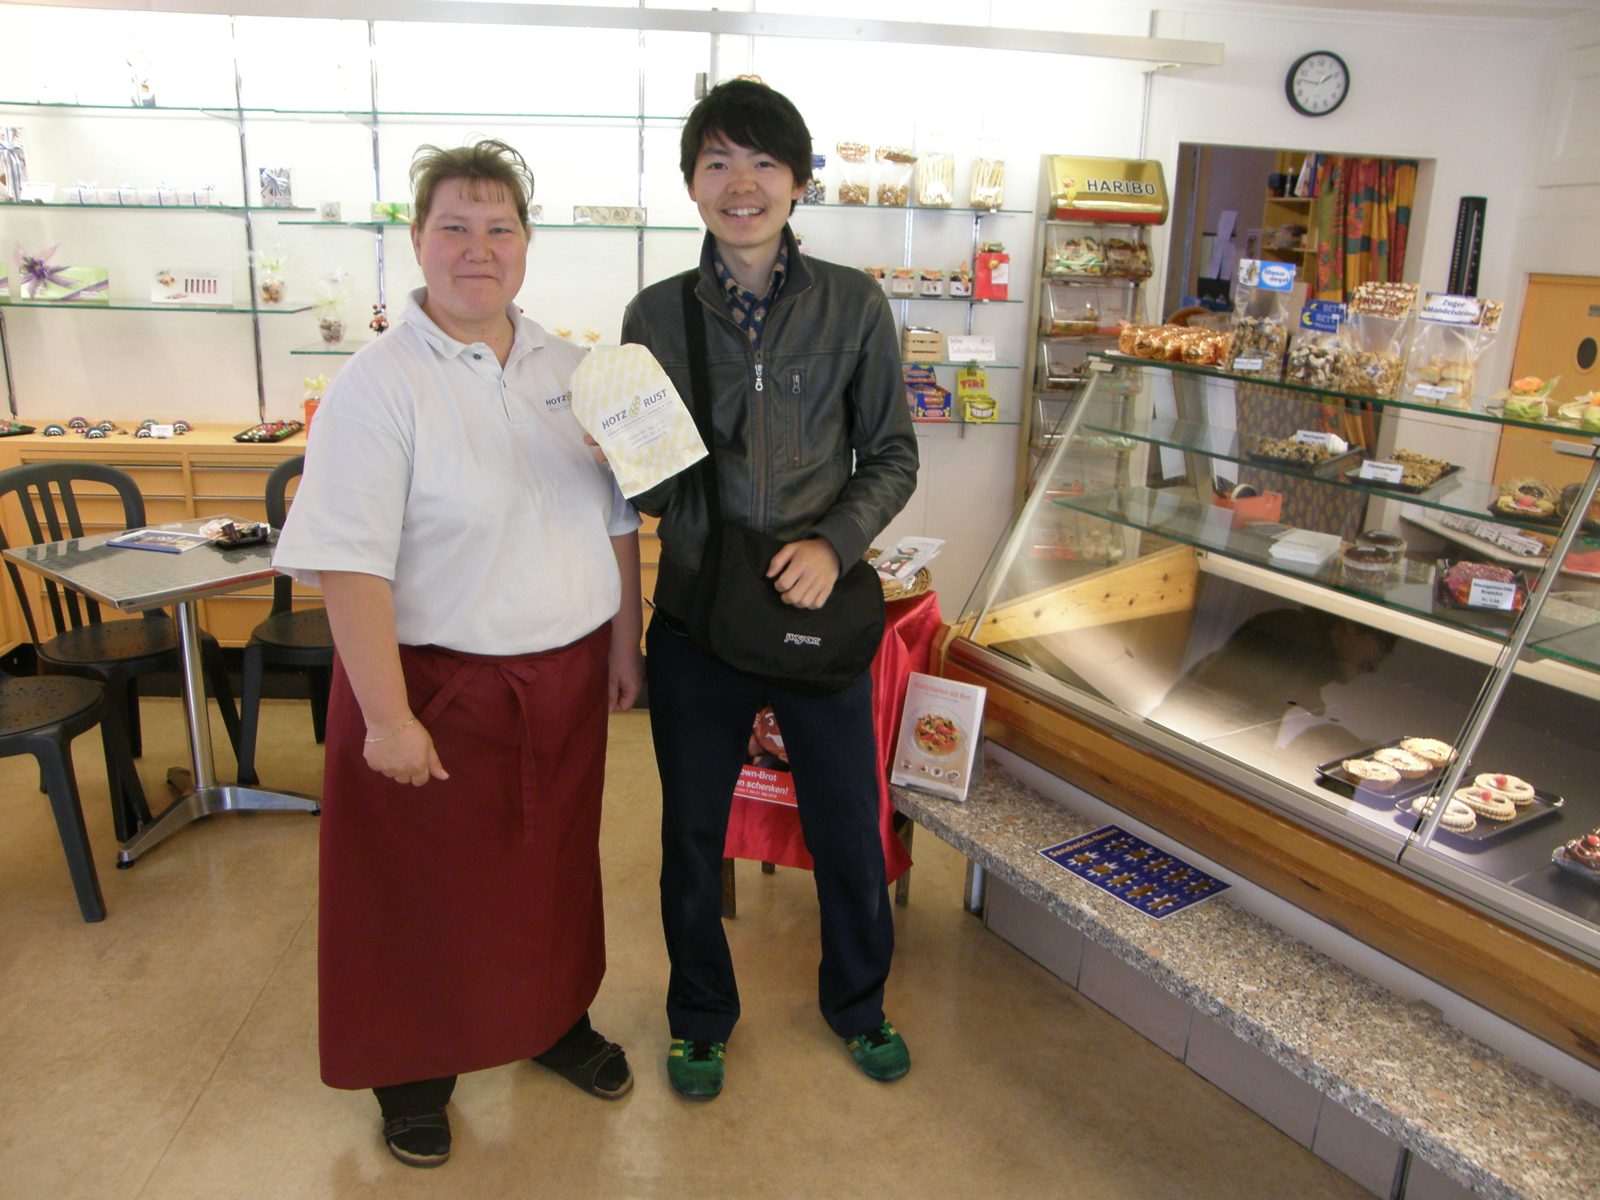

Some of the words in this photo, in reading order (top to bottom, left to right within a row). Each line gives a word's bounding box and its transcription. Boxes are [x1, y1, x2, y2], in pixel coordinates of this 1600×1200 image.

[1086, 178, 1156, 196] HARIBO
[545, 394, 567, 406] HOTZ
[602, 409, 628, 429] HOTZ
[643, 388, 667, 408] RUST
[746, 781, 789, 795] schenken!
